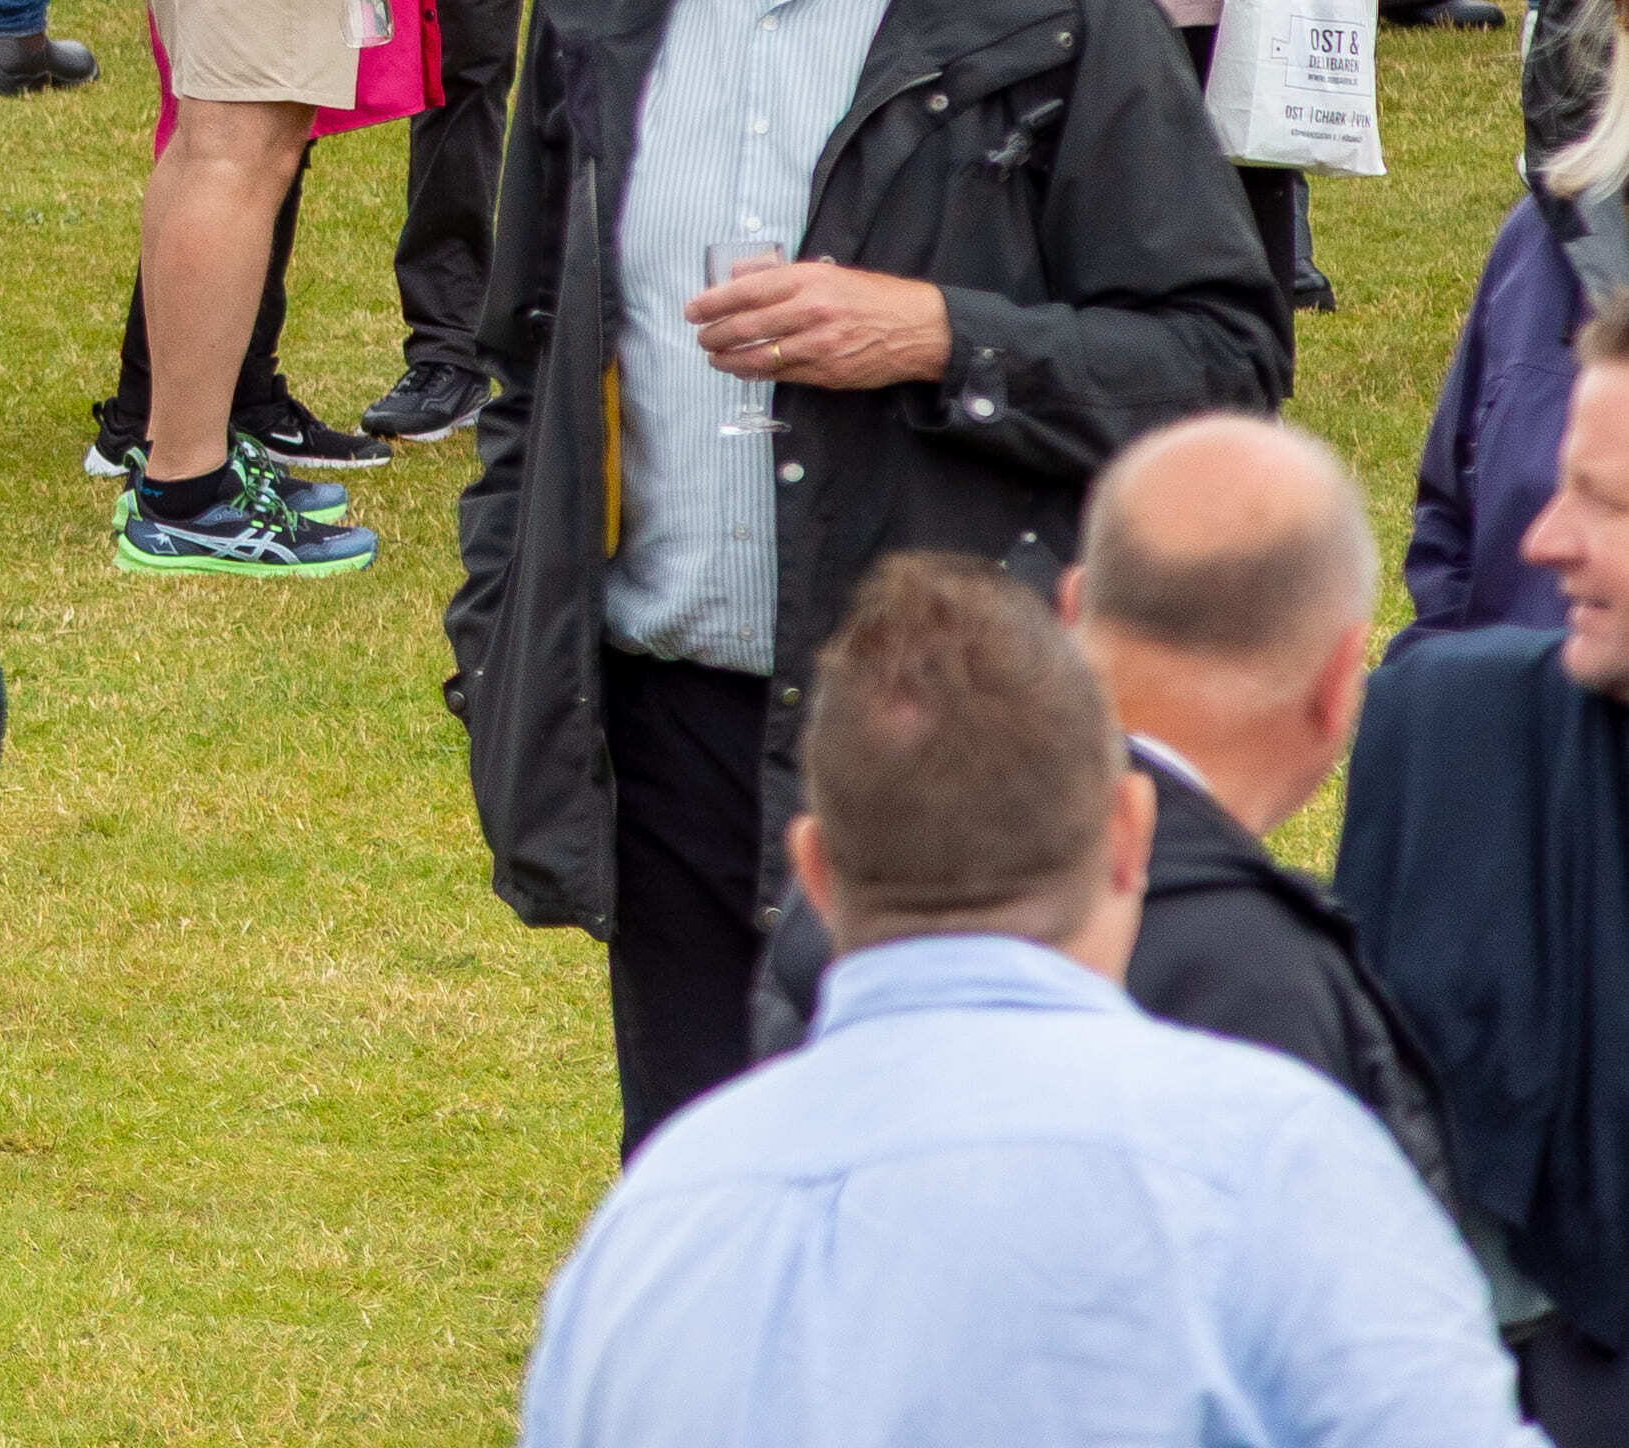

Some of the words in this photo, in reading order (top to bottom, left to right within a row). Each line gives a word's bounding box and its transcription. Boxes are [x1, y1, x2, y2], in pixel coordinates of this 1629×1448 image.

[1310, 28, 1345, 54] OST
[1350, 30, 1359, 55] &
[1285, 104, 1304, 121] OST
